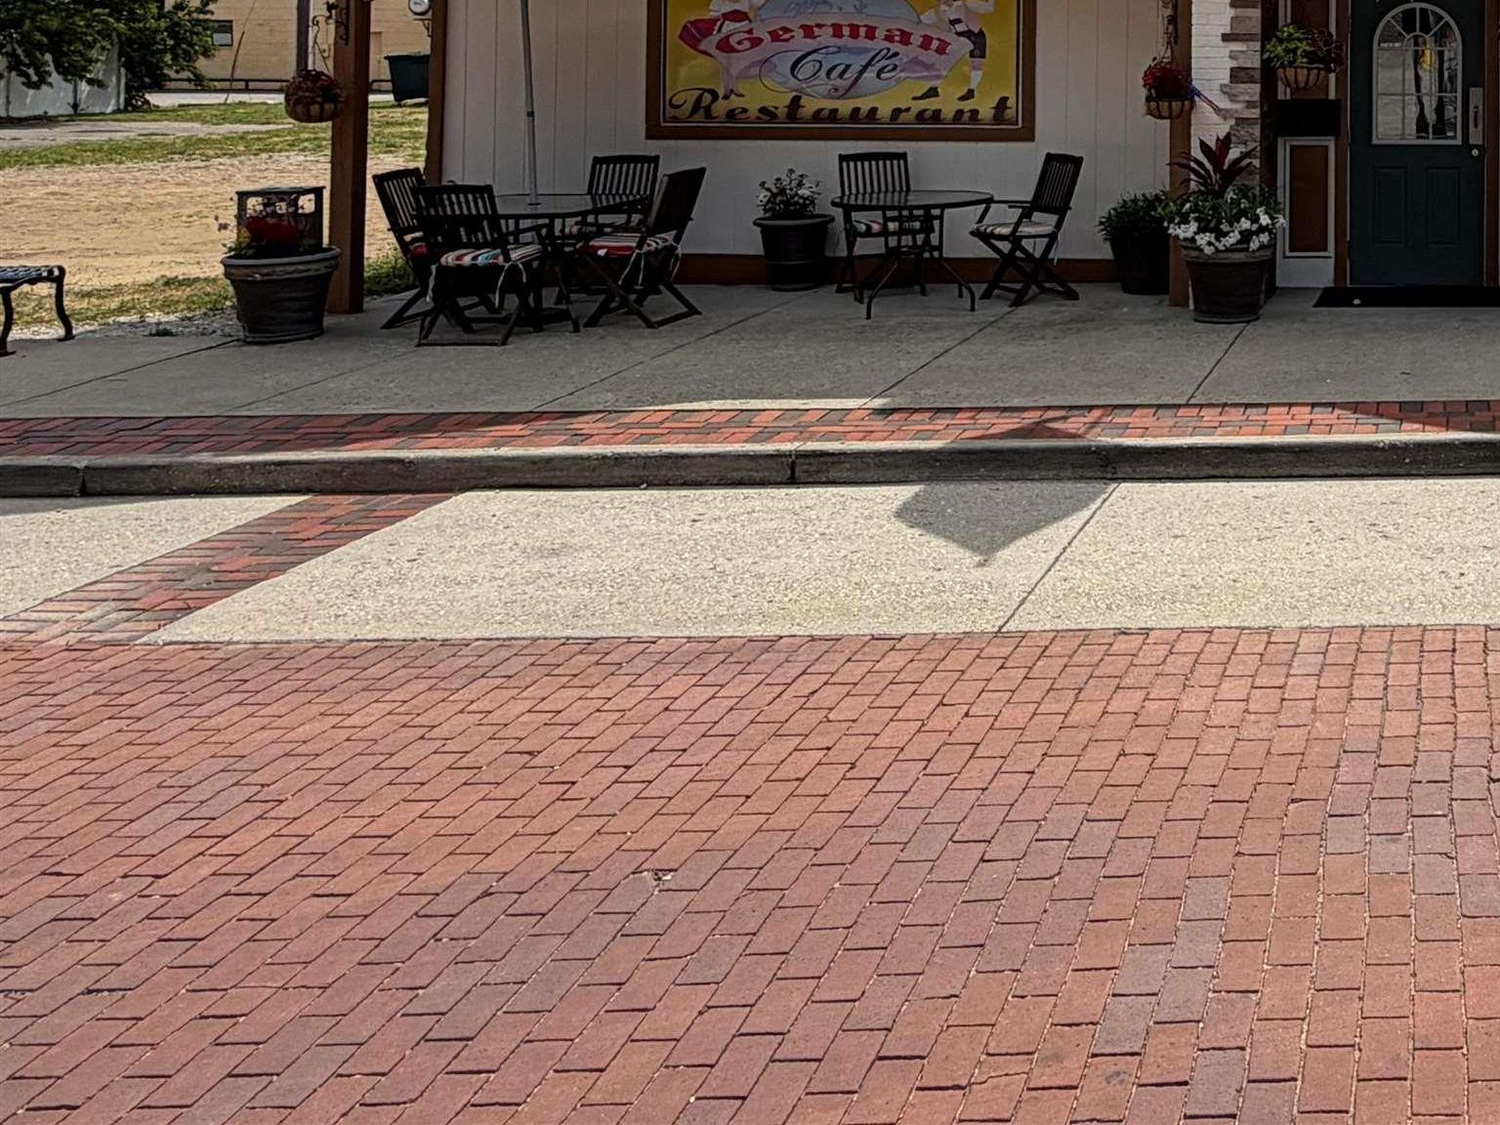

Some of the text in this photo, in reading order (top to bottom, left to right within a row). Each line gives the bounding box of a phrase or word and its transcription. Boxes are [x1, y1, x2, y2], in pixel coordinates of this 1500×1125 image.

[714, 21, 952, 56] German
[759, 46, 901, 98] Café
[668, 87, 1013, 122] Restaurant
